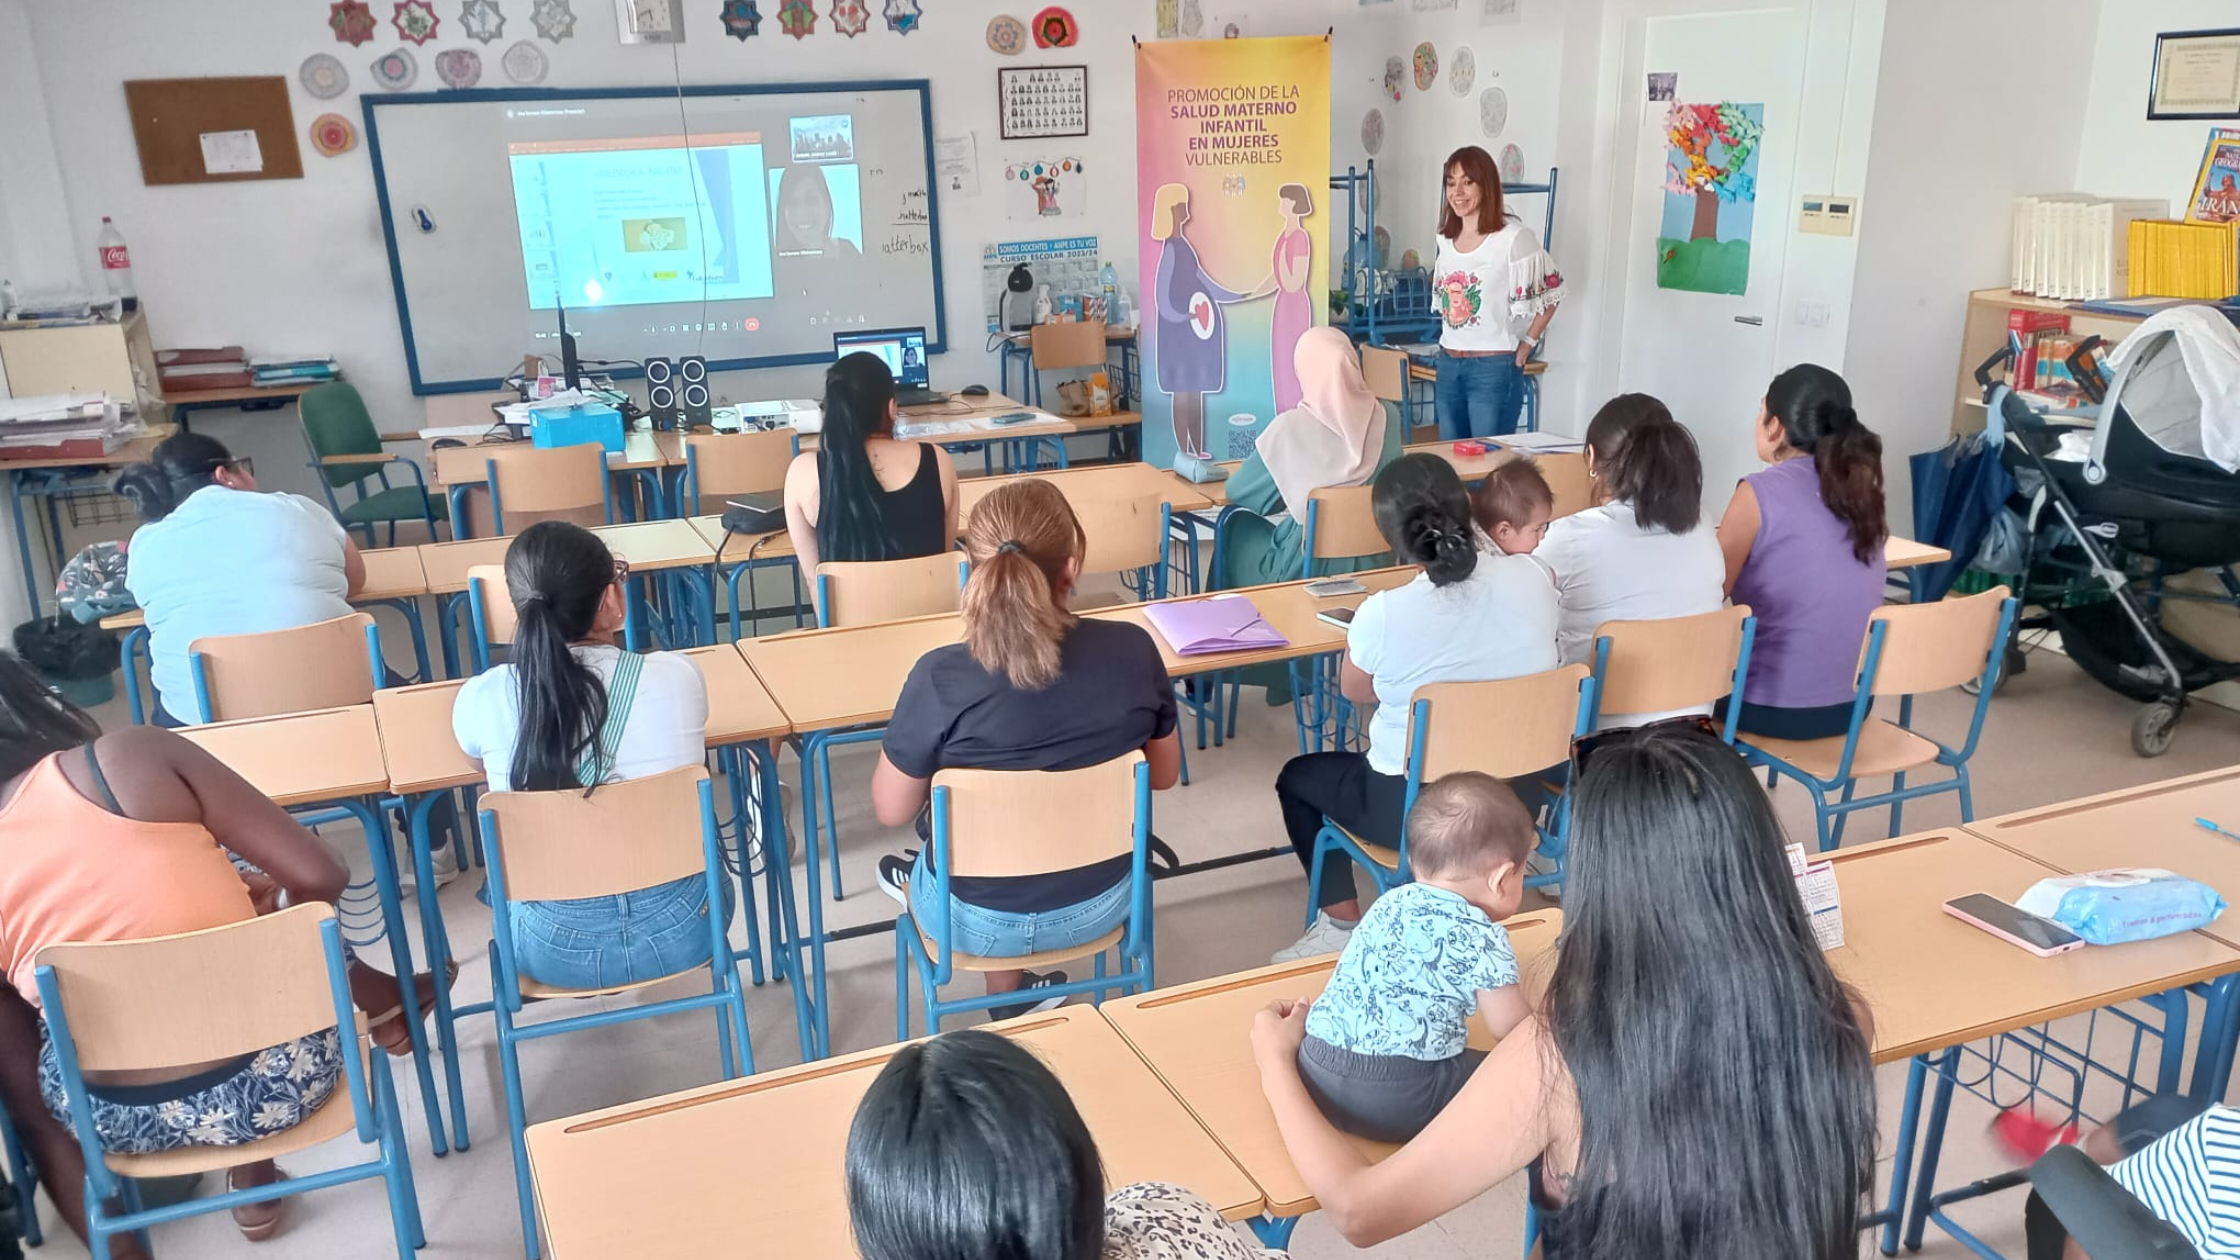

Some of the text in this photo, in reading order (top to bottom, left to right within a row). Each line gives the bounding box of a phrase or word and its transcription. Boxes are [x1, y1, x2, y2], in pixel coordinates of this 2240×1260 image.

[1168, 84, 1300, 103] PROMOCIÓN DE LA
[1171, 101, 1297, 119] SALUD MATERNO
[1200, 119, 1267, 134] INFANTIL
[1189, 134, 1279, 150] EN MUJERES
[1185, 150, 1282, 166] VULNERABLES
[999, 244, 1020, 254] SOMOS
[1021, 242, 1048, 252] DOCENTES
[1000, 249, 1098, 263] CURSO ESCOLAR 2023/24
